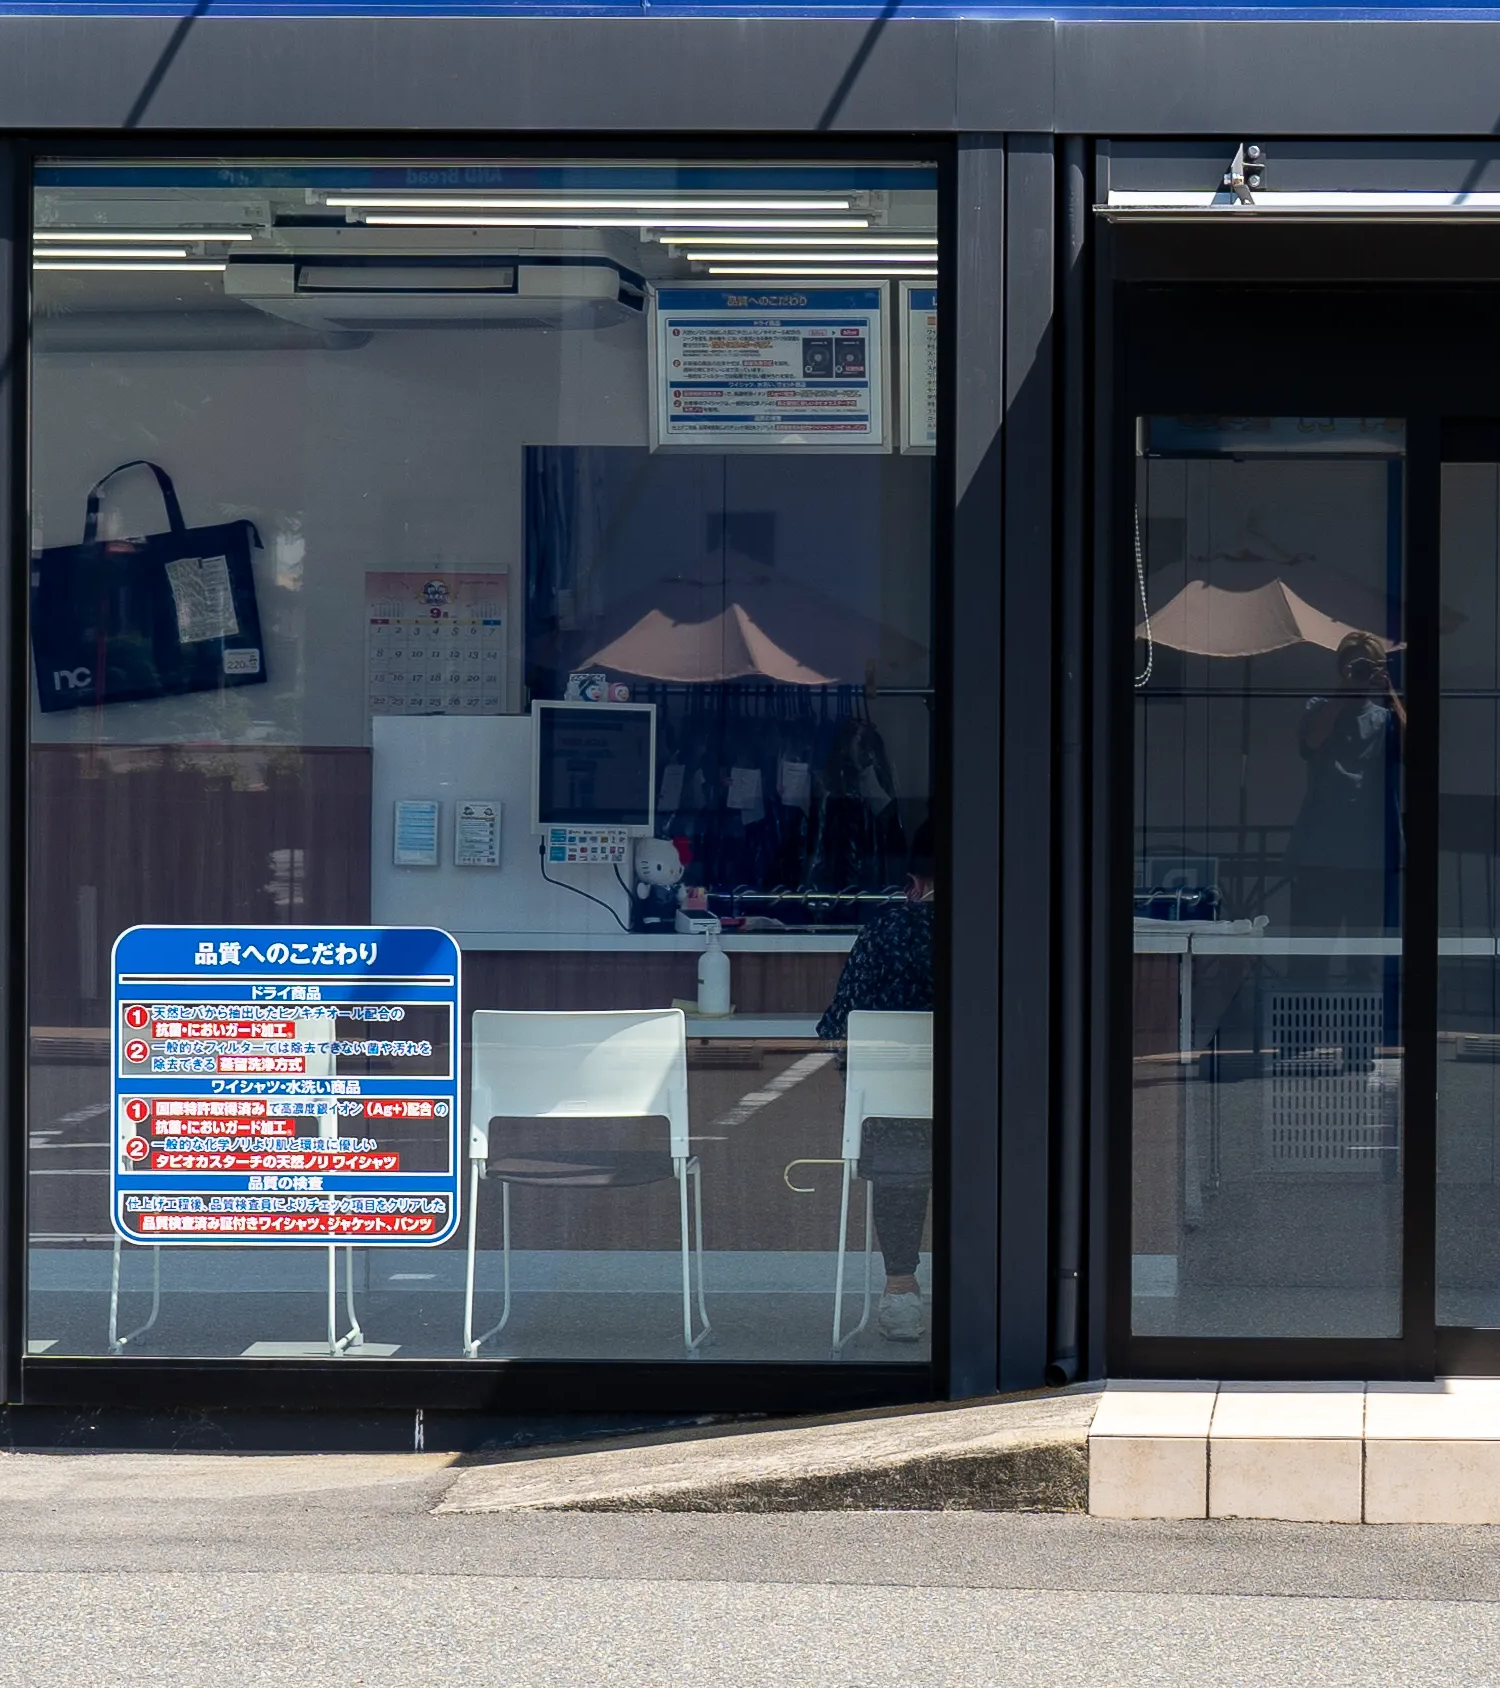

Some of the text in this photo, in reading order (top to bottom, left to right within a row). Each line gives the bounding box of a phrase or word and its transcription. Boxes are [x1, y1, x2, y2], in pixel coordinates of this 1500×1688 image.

[429, 608, 441, 618] 9
[194, 942, 378, 966] 品質へのこだわり
[251, 986, 321, 1000] ドライ商品
[211, 1080, 361, 1095] ワイシャツ・水洗い商品
[248, 1176, 323, 1191] 品質の検査
